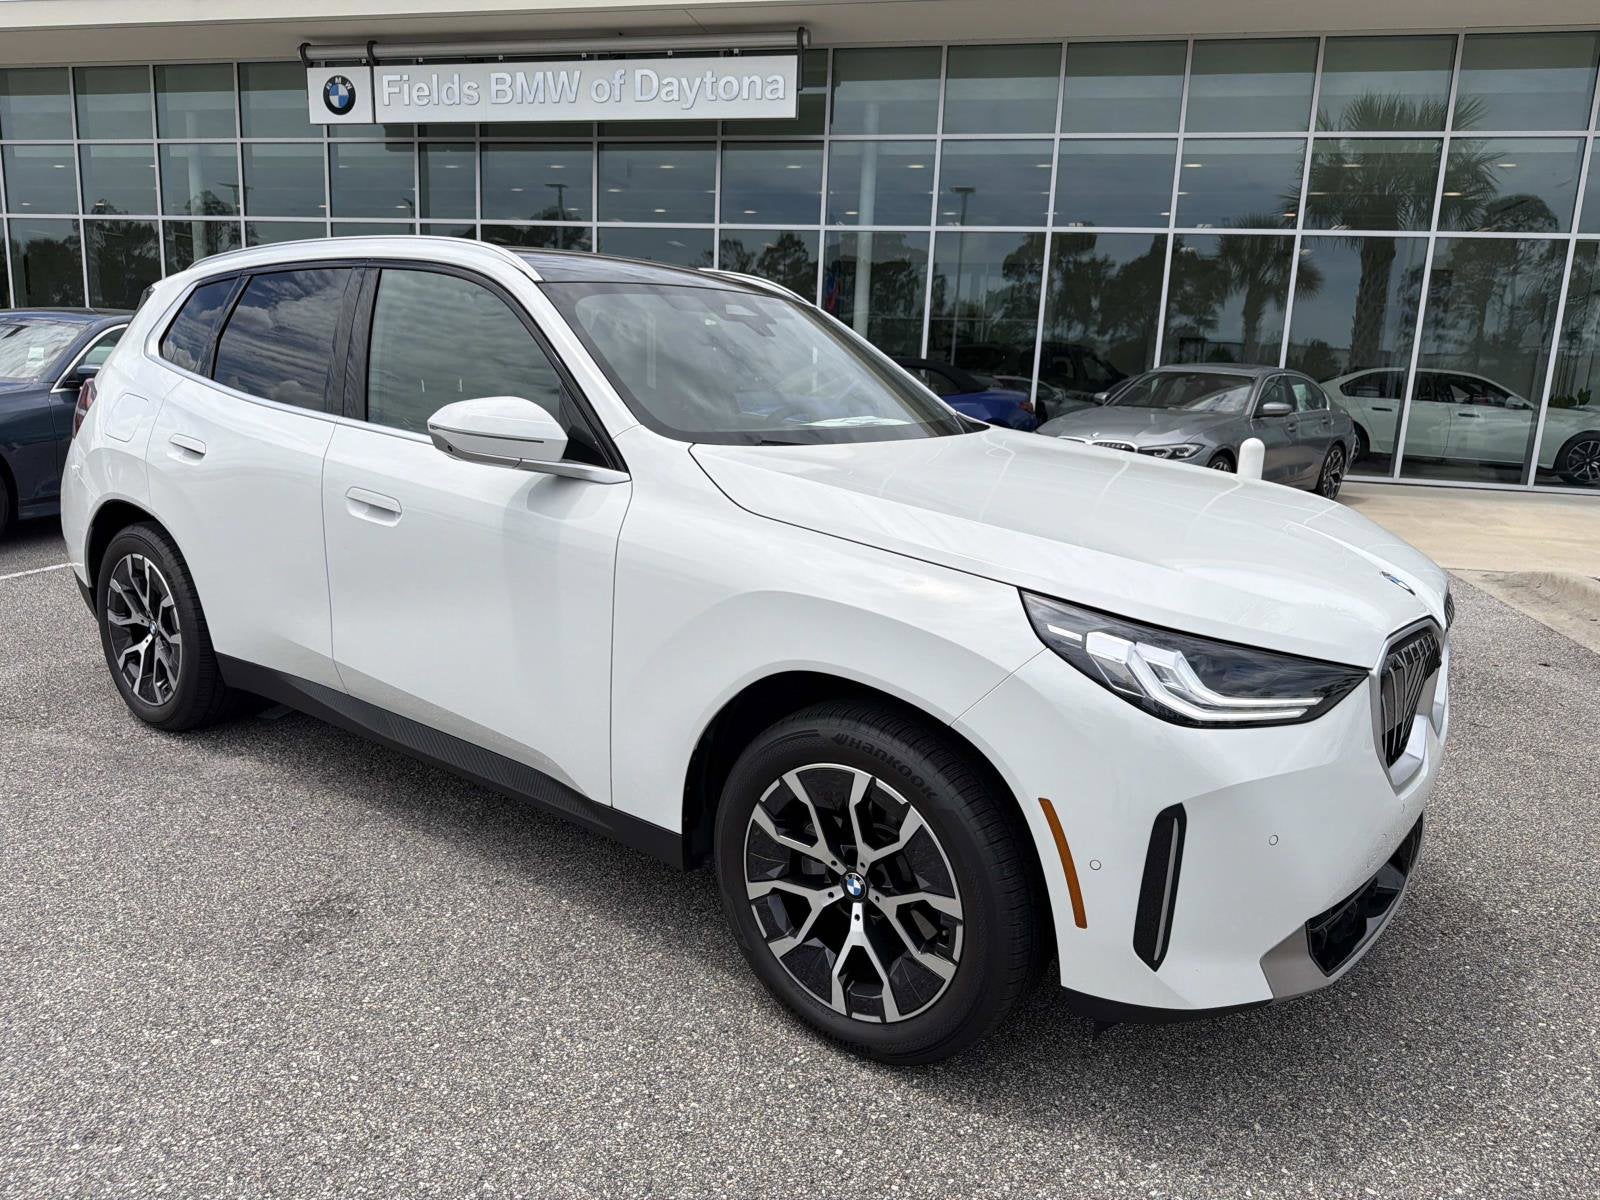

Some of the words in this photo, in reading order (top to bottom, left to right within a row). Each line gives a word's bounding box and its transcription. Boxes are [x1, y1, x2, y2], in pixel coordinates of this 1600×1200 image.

[382, 73, 480, 106] Fields
[490, 70, 581, 105] BMW
[590, 68, 626, 104] of
[634, 68, 786, 110] Daytona
